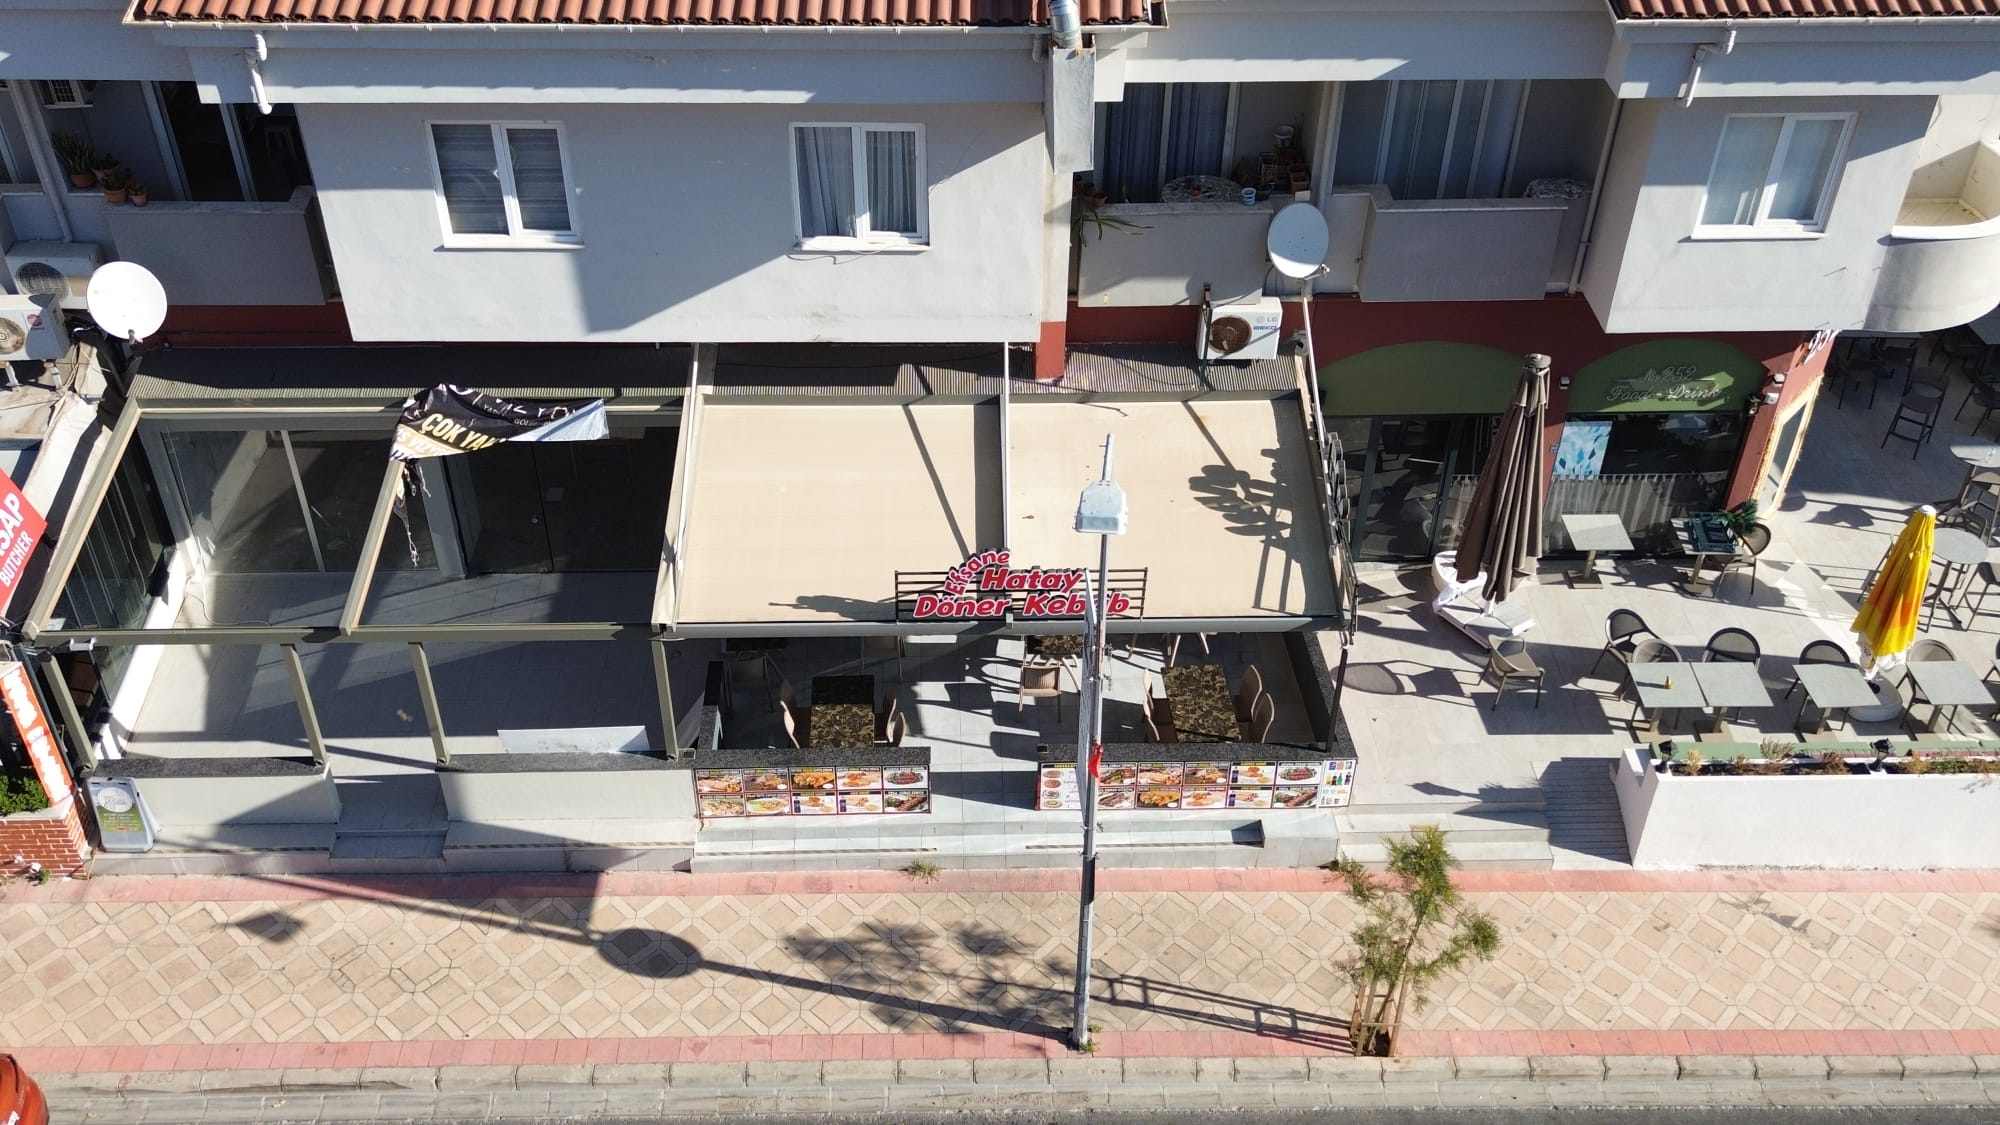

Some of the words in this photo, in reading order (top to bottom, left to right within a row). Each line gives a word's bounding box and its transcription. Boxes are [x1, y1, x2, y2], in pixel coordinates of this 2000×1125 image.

[1661, 365, 1697, 381] 252
[1606, 383, 1655, 402] Food
[1667, 382, 1720, 400] Drink
[419, 413, 467, 444] ÇOK
[0, 530, 34, 588] BUTCHER
[944, 551, 1010, 596] Efsane
[981, 567, 1083, 594] Hatay
[913, 594, 1012, 617] Döner
[1023, 592, 1130, 616] Kebb
